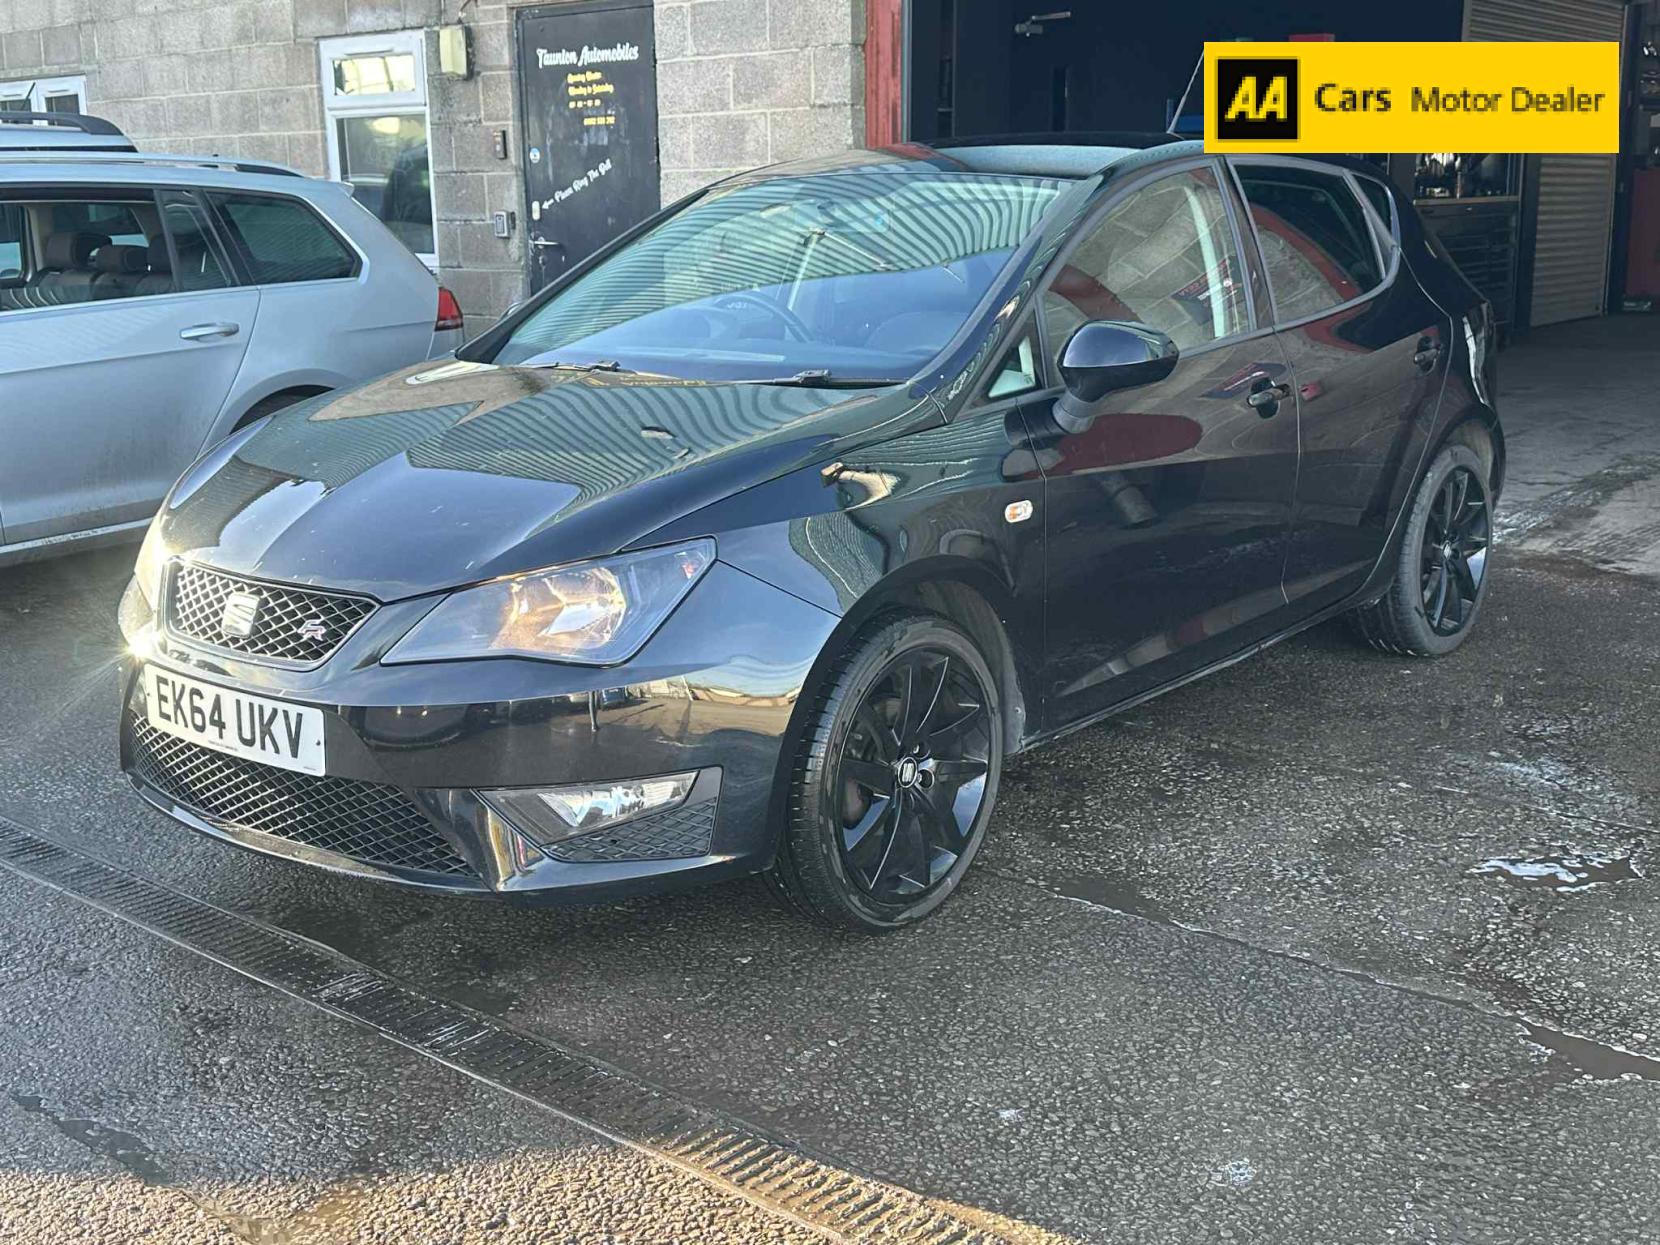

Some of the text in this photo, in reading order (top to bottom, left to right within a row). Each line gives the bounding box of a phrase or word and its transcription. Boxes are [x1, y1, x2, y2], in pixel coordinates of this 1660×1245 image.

[536, 42, 639, 69] Taunton Automobiles
[156, 675, 303, 759] EK64 UKV
